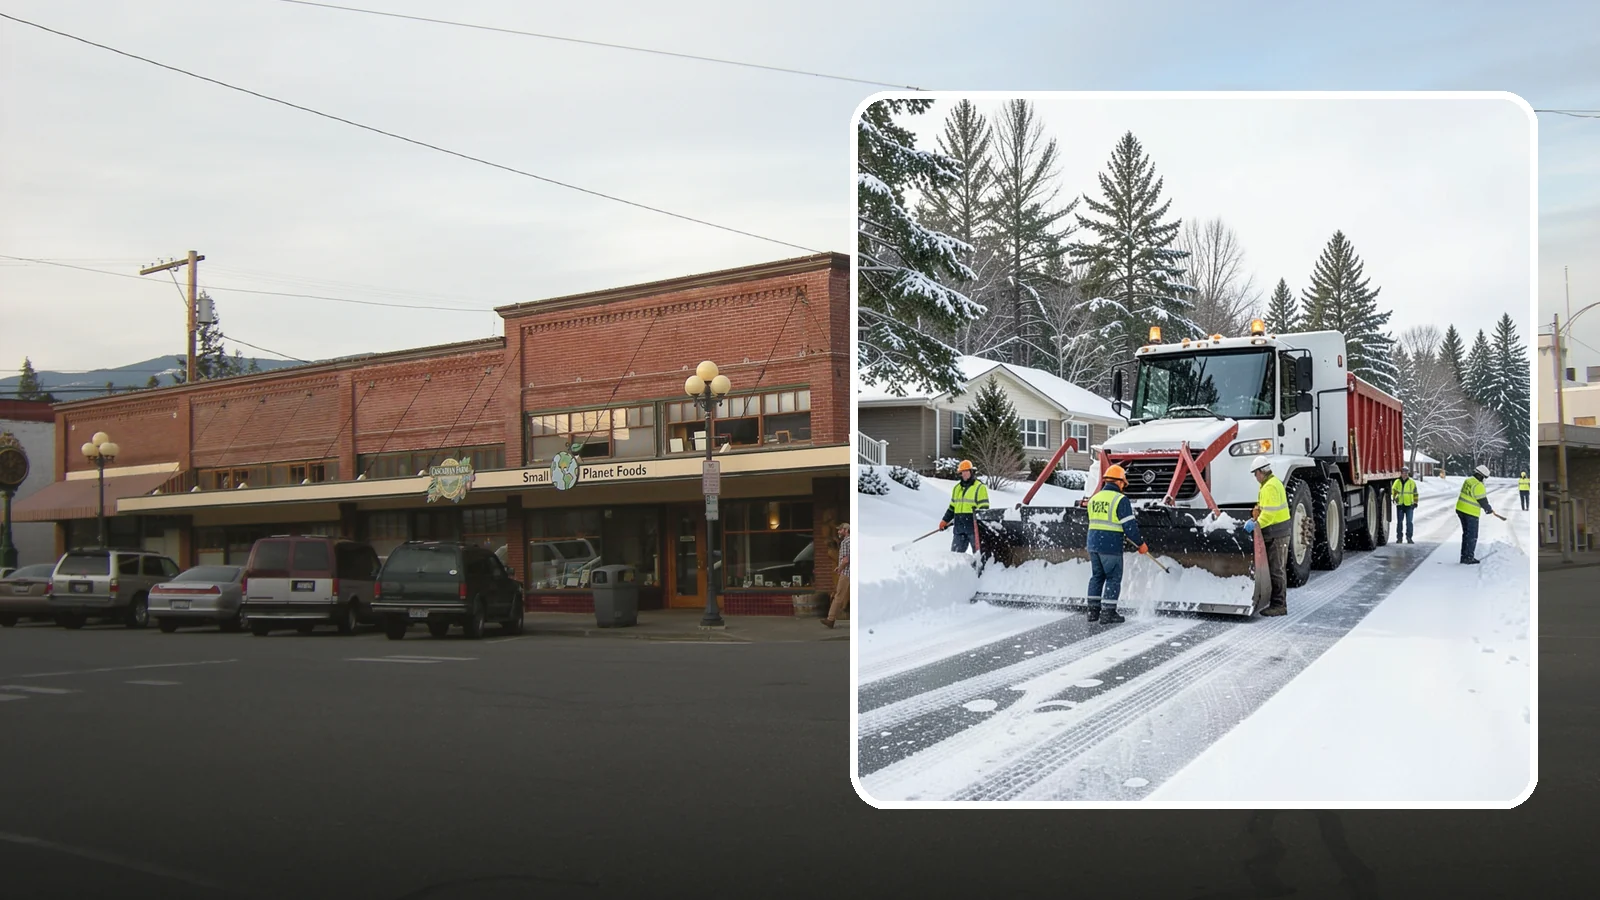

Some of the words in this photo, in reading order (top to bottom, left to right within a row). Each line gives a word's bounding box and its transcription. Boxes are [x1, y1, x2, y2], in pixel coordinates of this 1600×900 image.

[522, 470, 549, 483] Small
[582, 466, 614, 479] Planet
[616, 464, 647, 477] Foods
